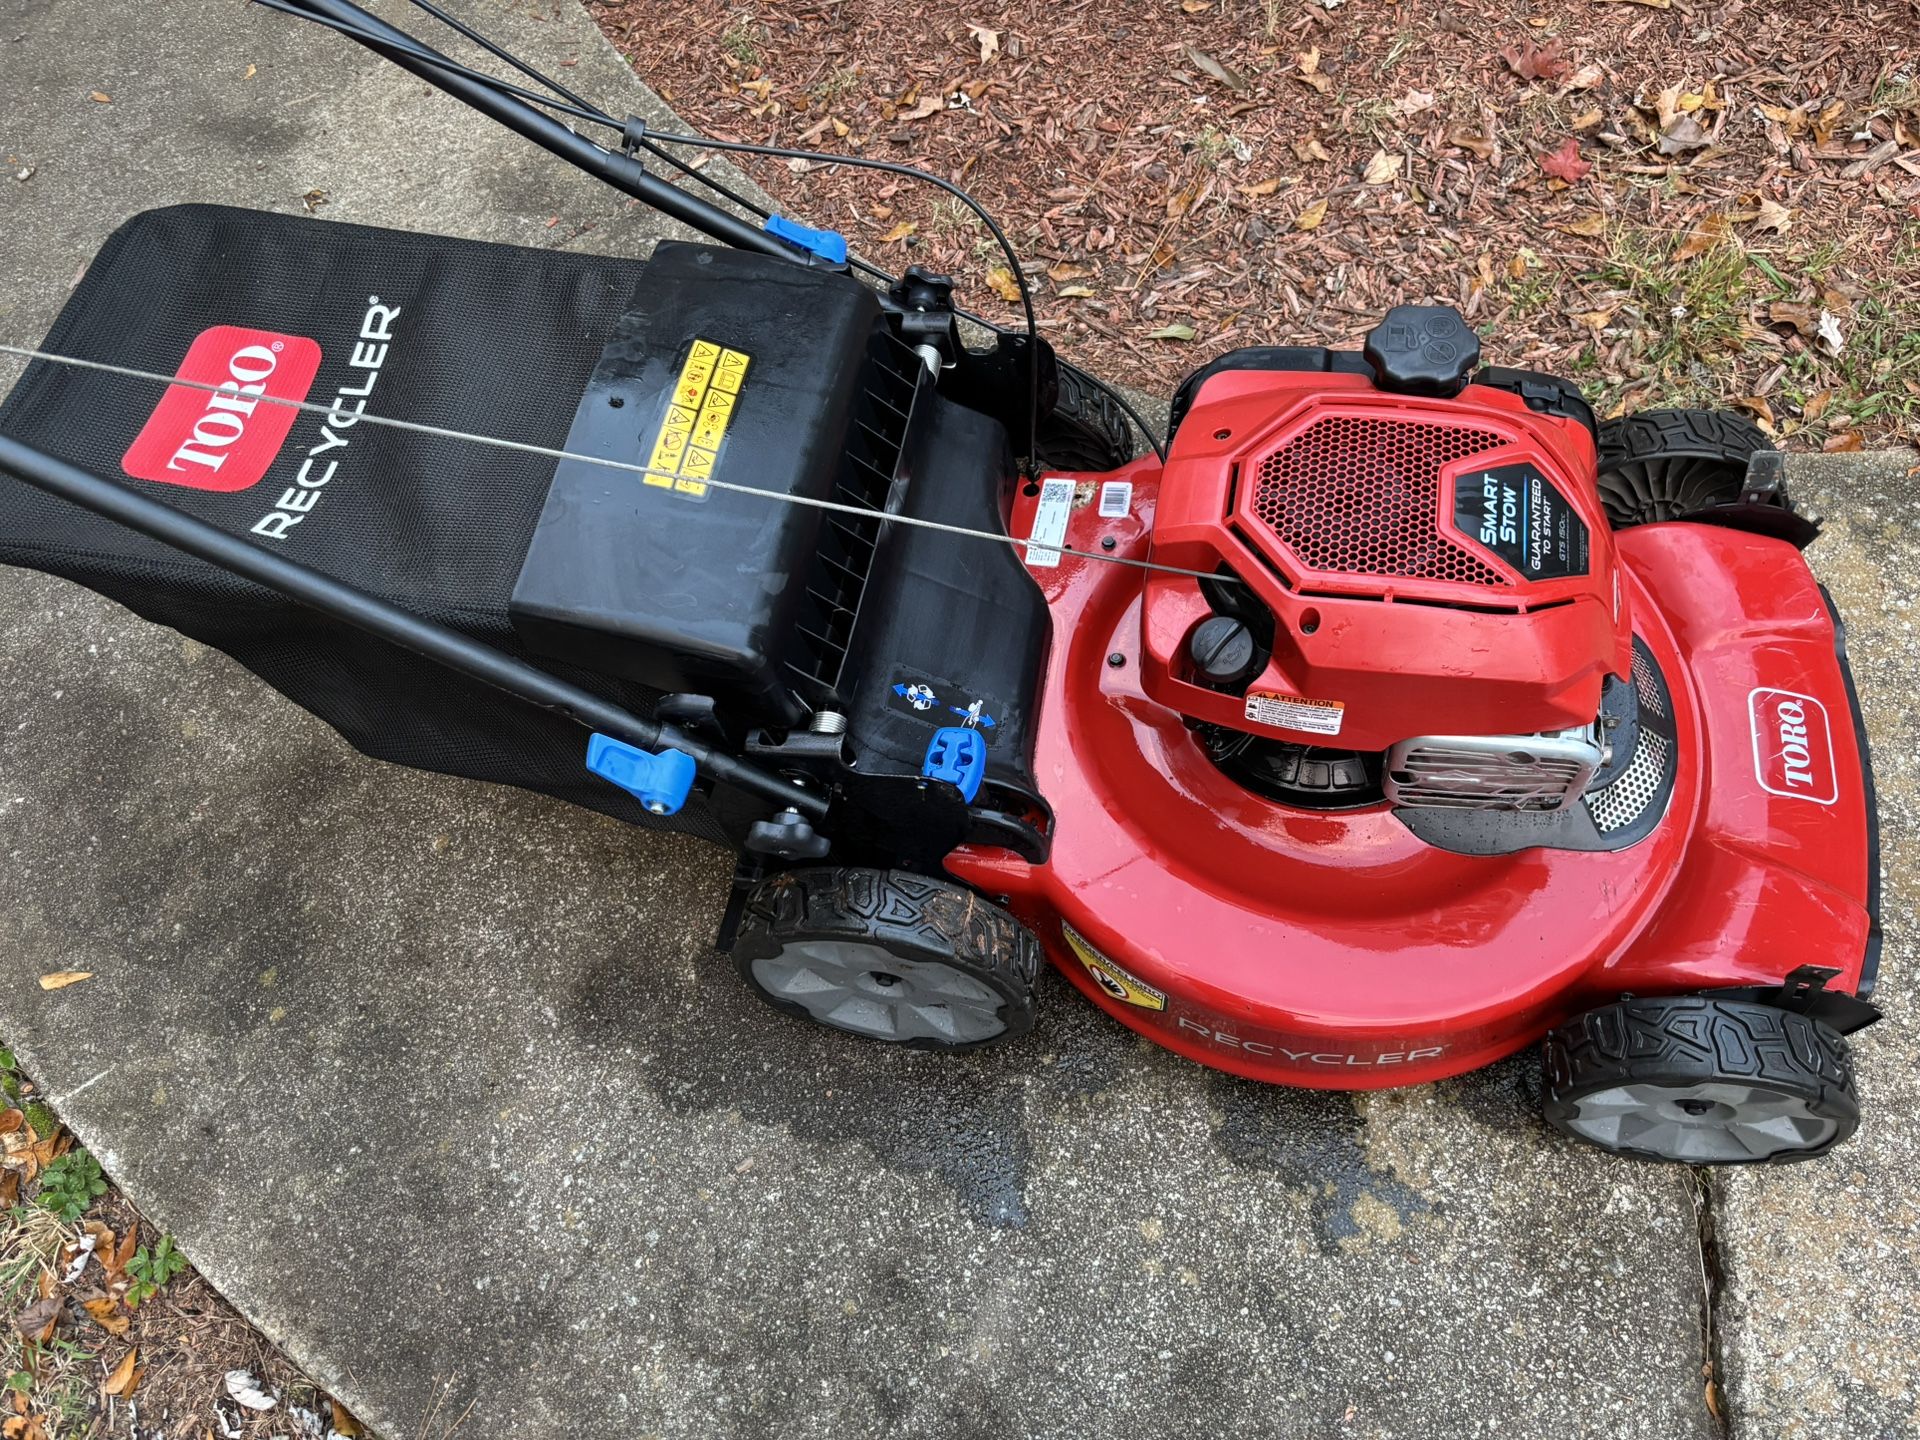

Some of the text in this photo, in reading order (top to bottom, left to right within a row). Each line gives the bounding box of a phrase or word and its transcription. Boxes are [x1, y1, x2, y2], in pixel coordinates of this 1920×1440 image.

[1480, 473, 1498, 546] SMART
[1531, 478, 1542, 570] GUARANTEED
[1543, 540, 1551, 555] TO
[1558, 540, 1566, 561] GTS
[1272, 693, 1334, 708] ATTENTION
[1178, 1016, 1443, 1065] RECYCLER
